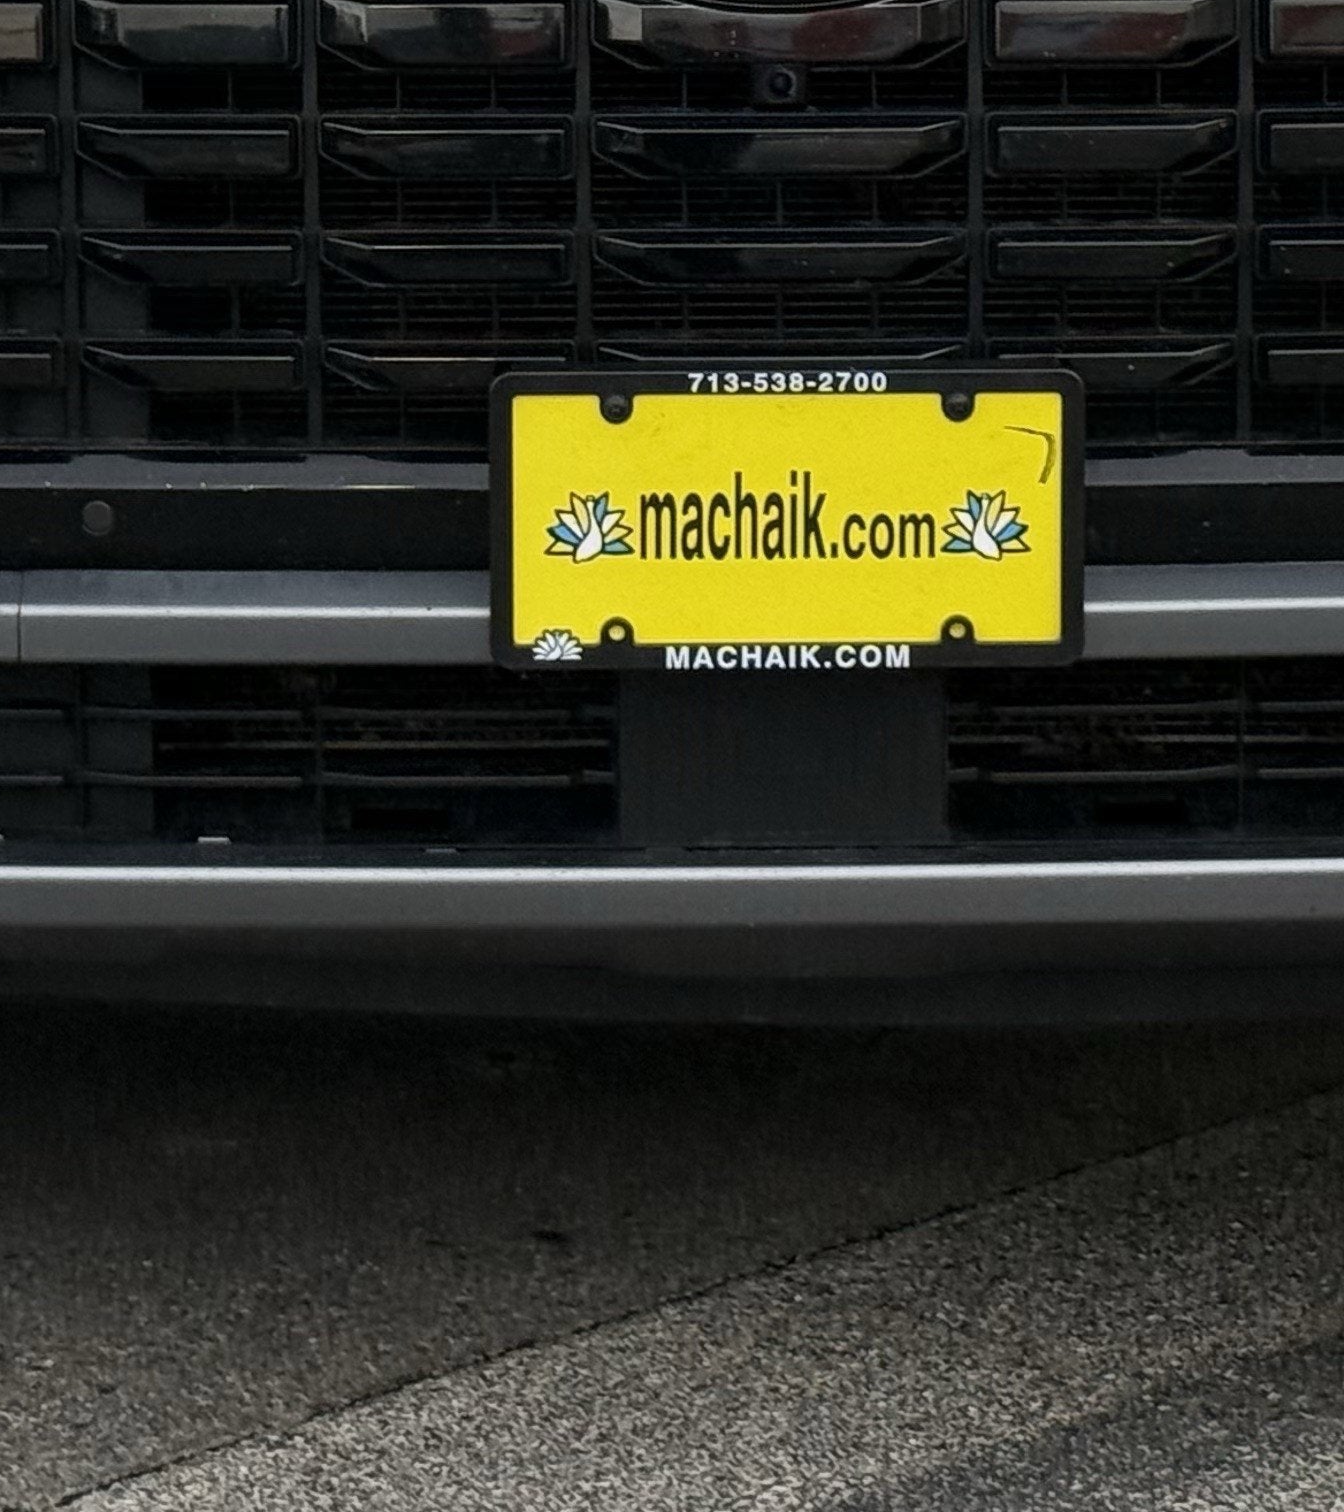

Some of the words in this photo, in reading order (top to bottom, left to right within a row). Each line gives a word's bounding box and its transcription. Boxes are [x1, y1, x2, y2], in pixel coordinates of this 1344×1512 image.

[688, 371, 888, 393] 713-538-2700
[640, 470, 935, 560] machaik.com
[665, 644, 911, 670] MACHAIK.COM
